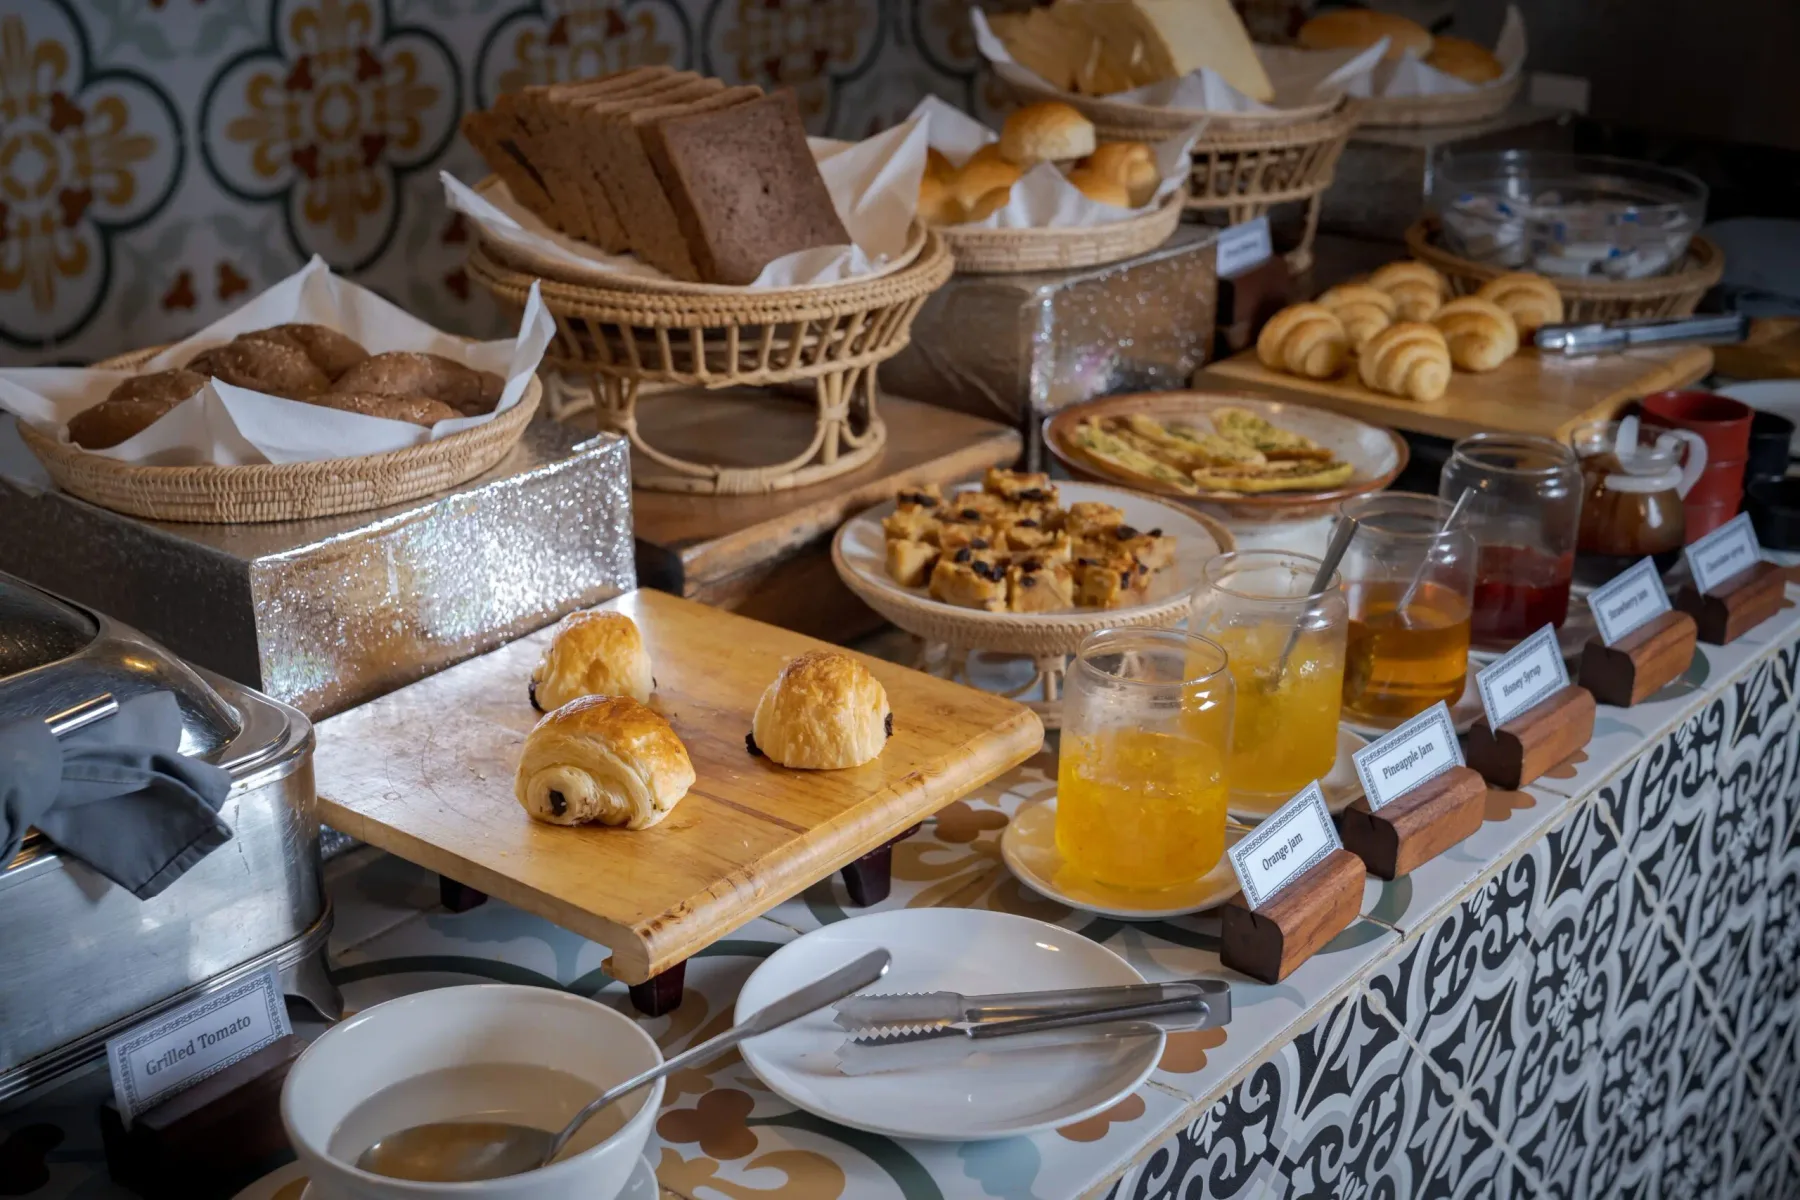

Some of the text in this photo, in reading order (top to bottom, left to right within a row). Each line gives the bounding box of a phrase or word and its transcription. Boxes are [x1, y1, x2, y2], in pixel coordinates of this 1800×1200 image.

[1502, 665, 1541, 697] Honey Syrup
[1382, 742, 1434, 779] Pineapple Jam
[1262, 833, 1303, 871] Orange jam
[146, 1015, 251, 1076] Grilled Tomato
